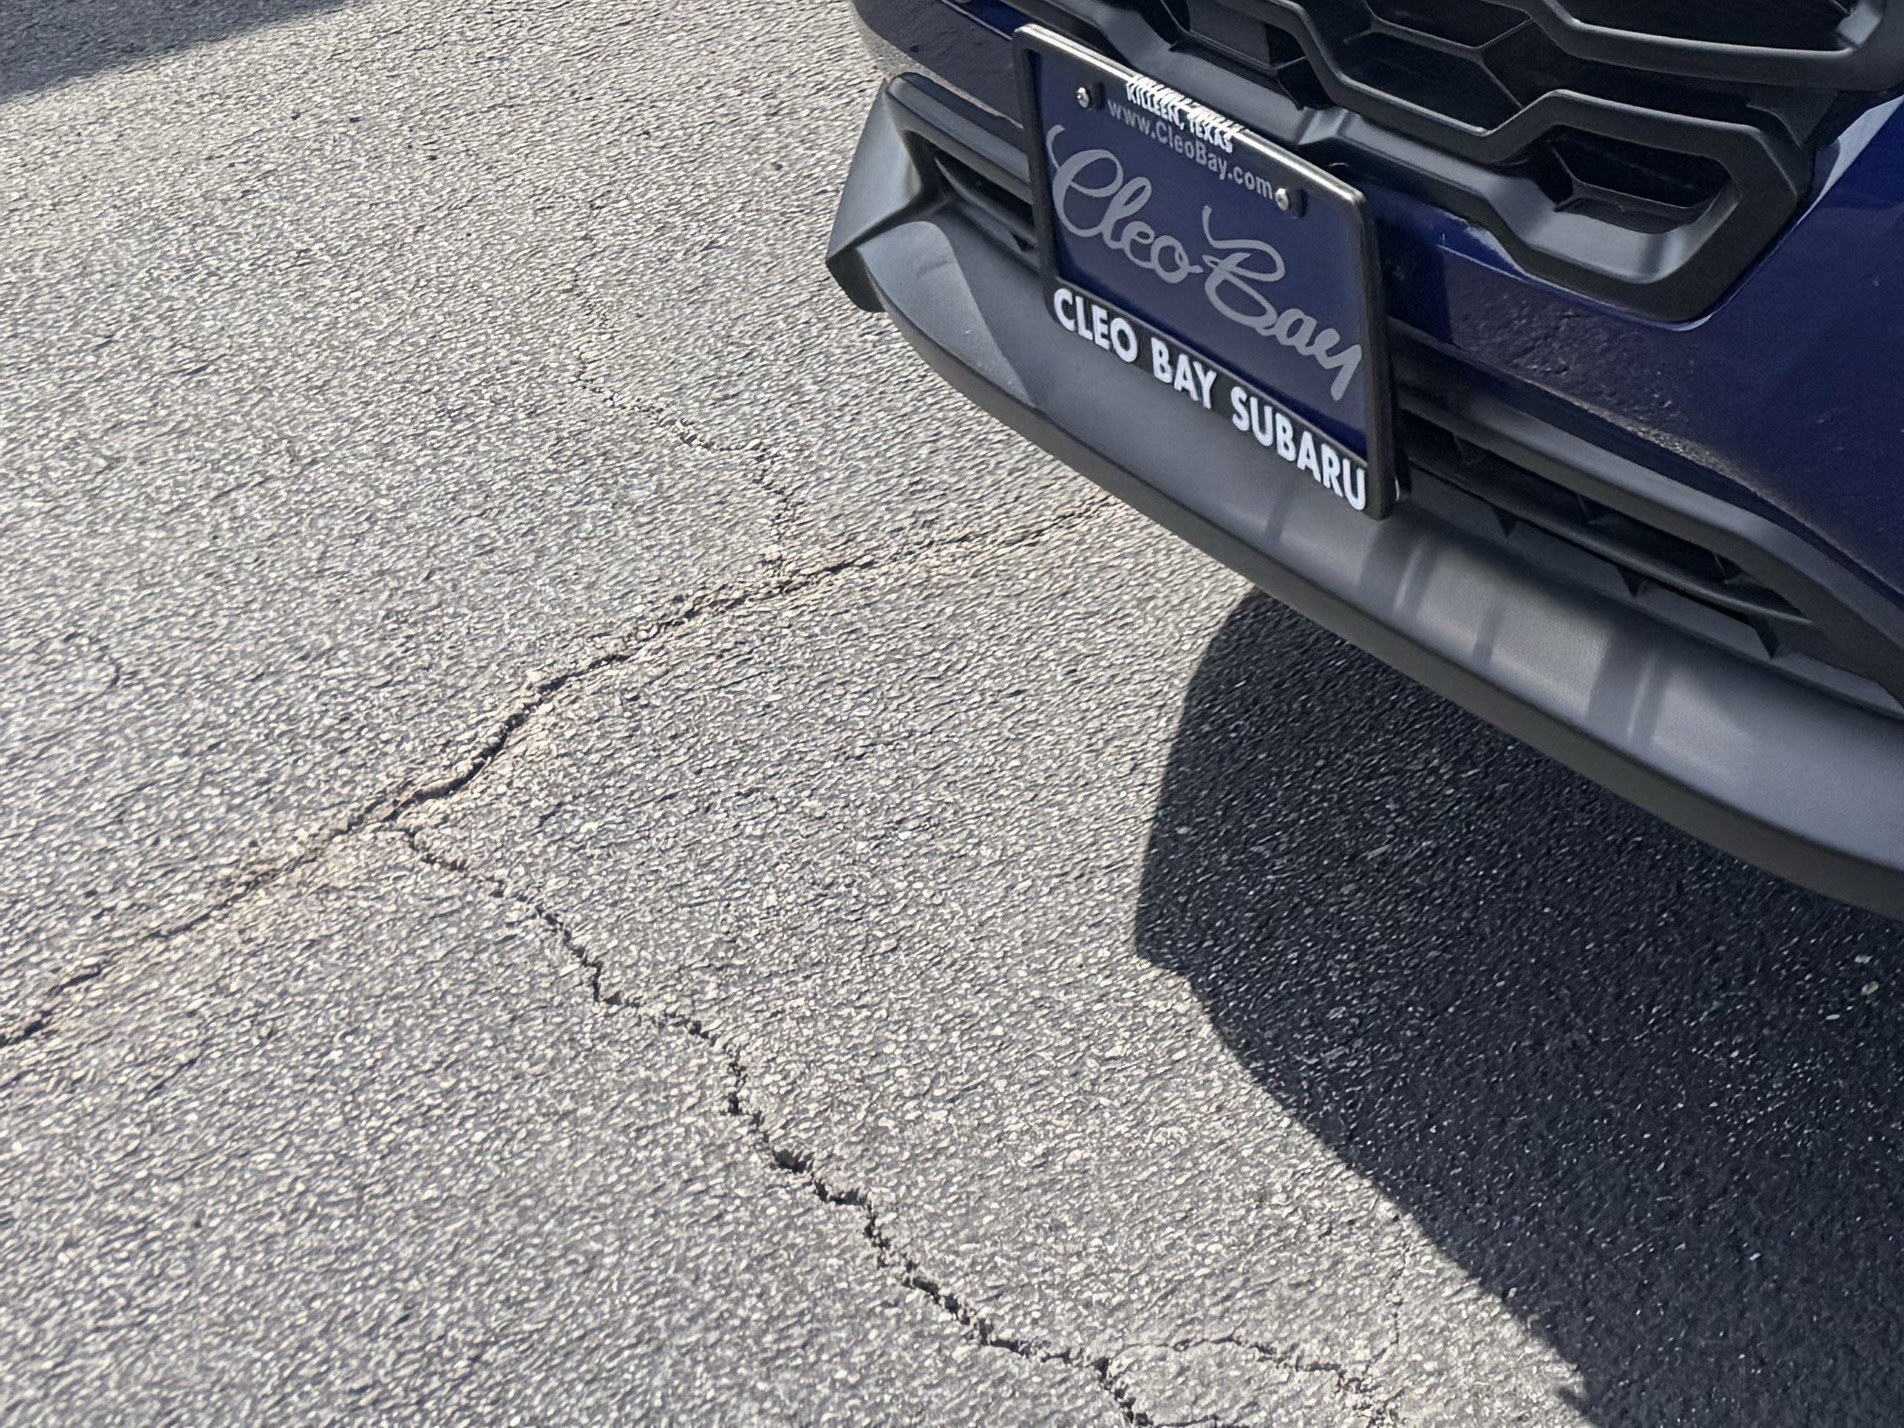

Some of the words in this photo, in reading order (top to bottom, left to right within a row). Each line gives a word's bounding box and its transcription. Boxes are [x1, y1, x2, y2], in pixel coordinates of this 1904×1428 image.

[1106, 98, 1274, 200] www.CleoBay.com
[1187, 110, 1234, 153] TEXAS
[1045, 124, 1204, 284] Cleo
[1202, 204, 1363, 402] Bay
[1053, 286, 1139, 364] CLEO
[1151, 335, 1217, 410] BAY
[1230, 385, 1368, 512] SUBARU
